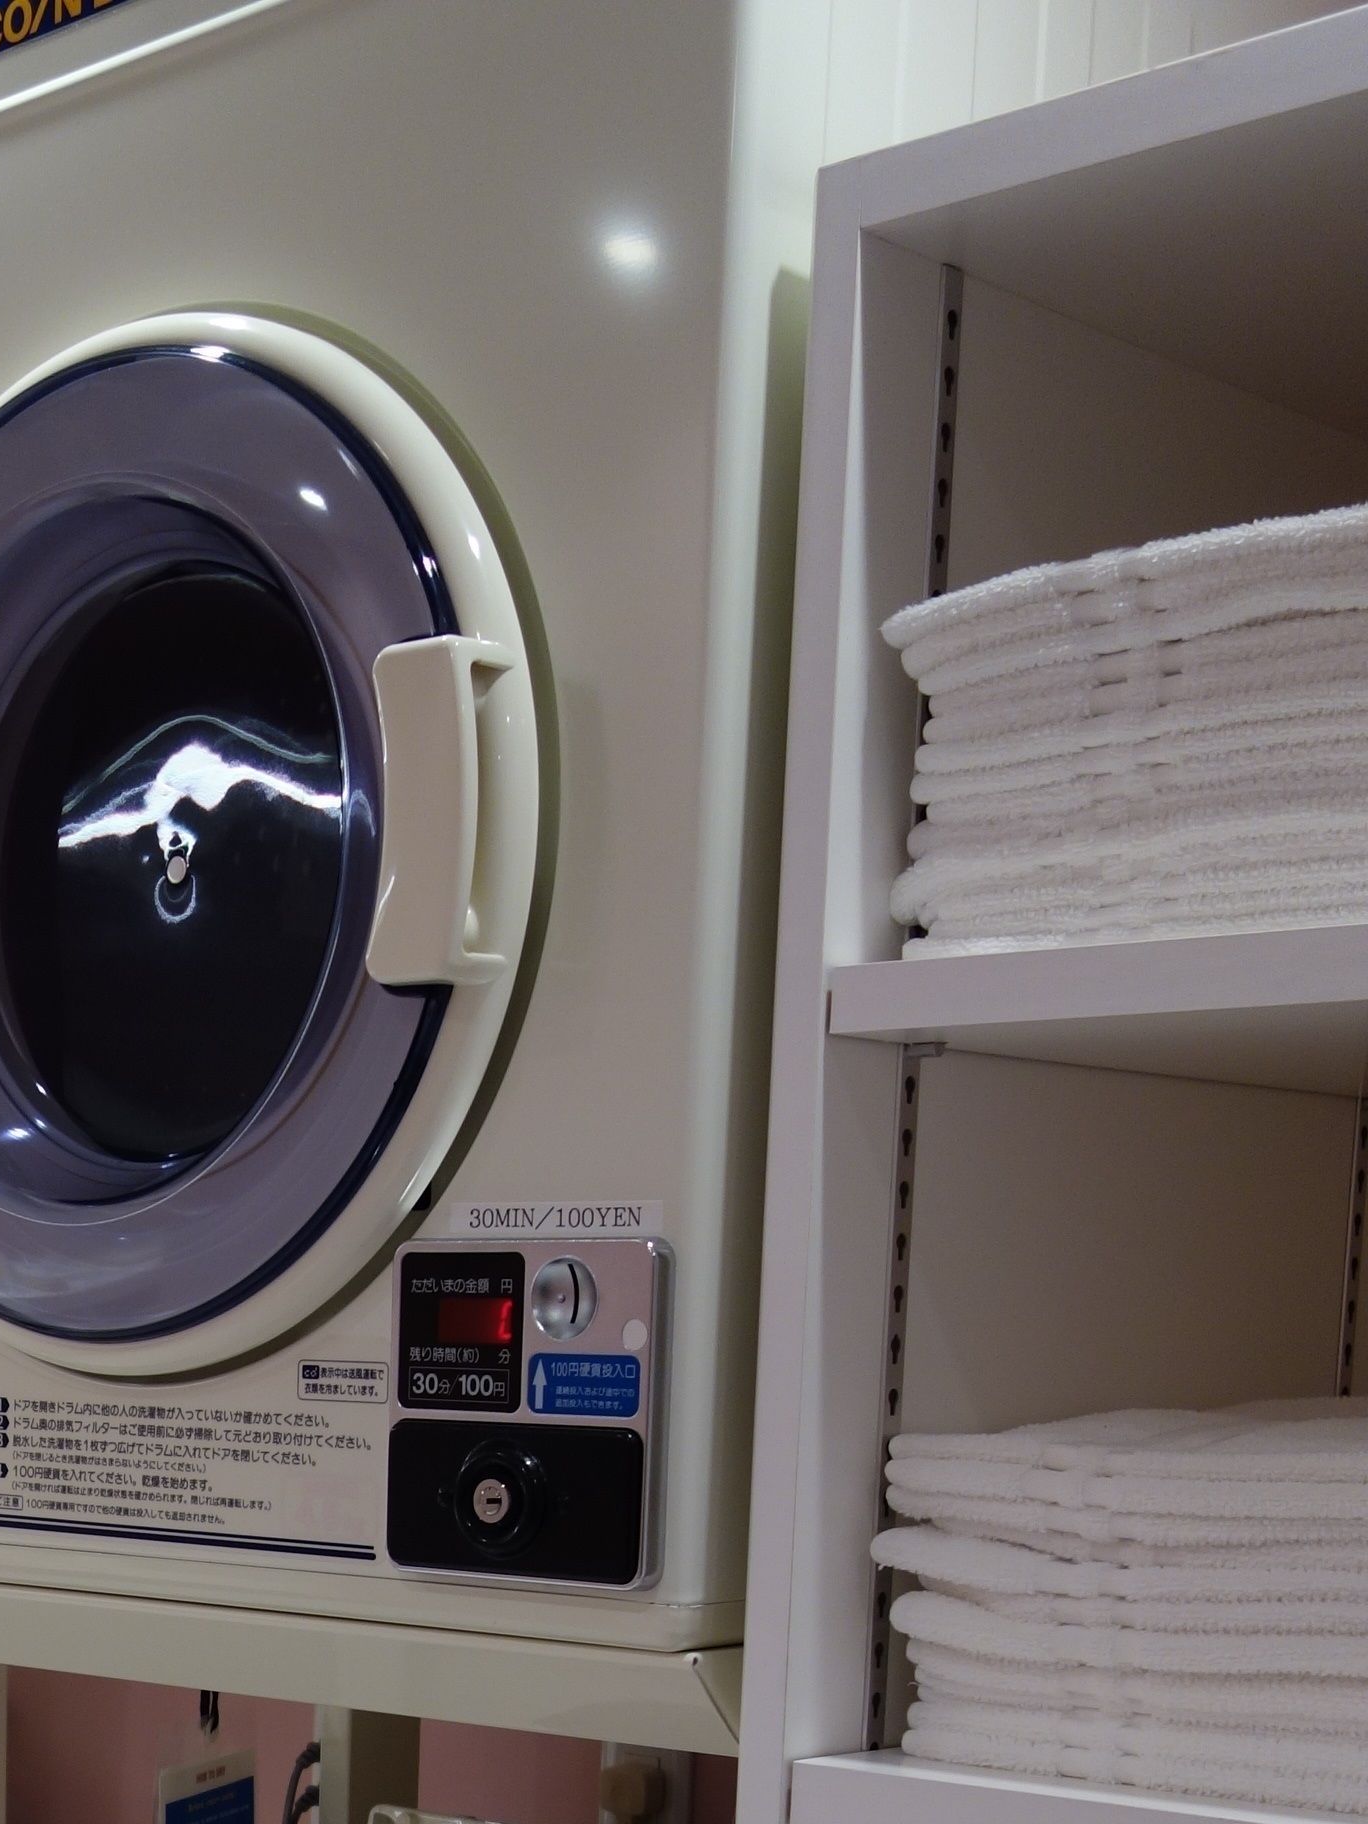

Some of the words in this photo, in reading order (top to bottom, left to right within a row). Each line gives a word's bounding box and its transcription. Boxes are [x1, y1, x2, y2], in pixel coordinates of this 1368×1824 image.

[470, 1207, 642, 1230] 30MIN/100YEN
[411, 1278, 489, 1293] ただいまの金額
[501, 1279, 512, 1293] 円
[499, 1349, 511, 1364] 分
[551, 1362, 635, 1378] 100円硬貨投入口
[413, 1373, 505, 1396] 30分/100円
